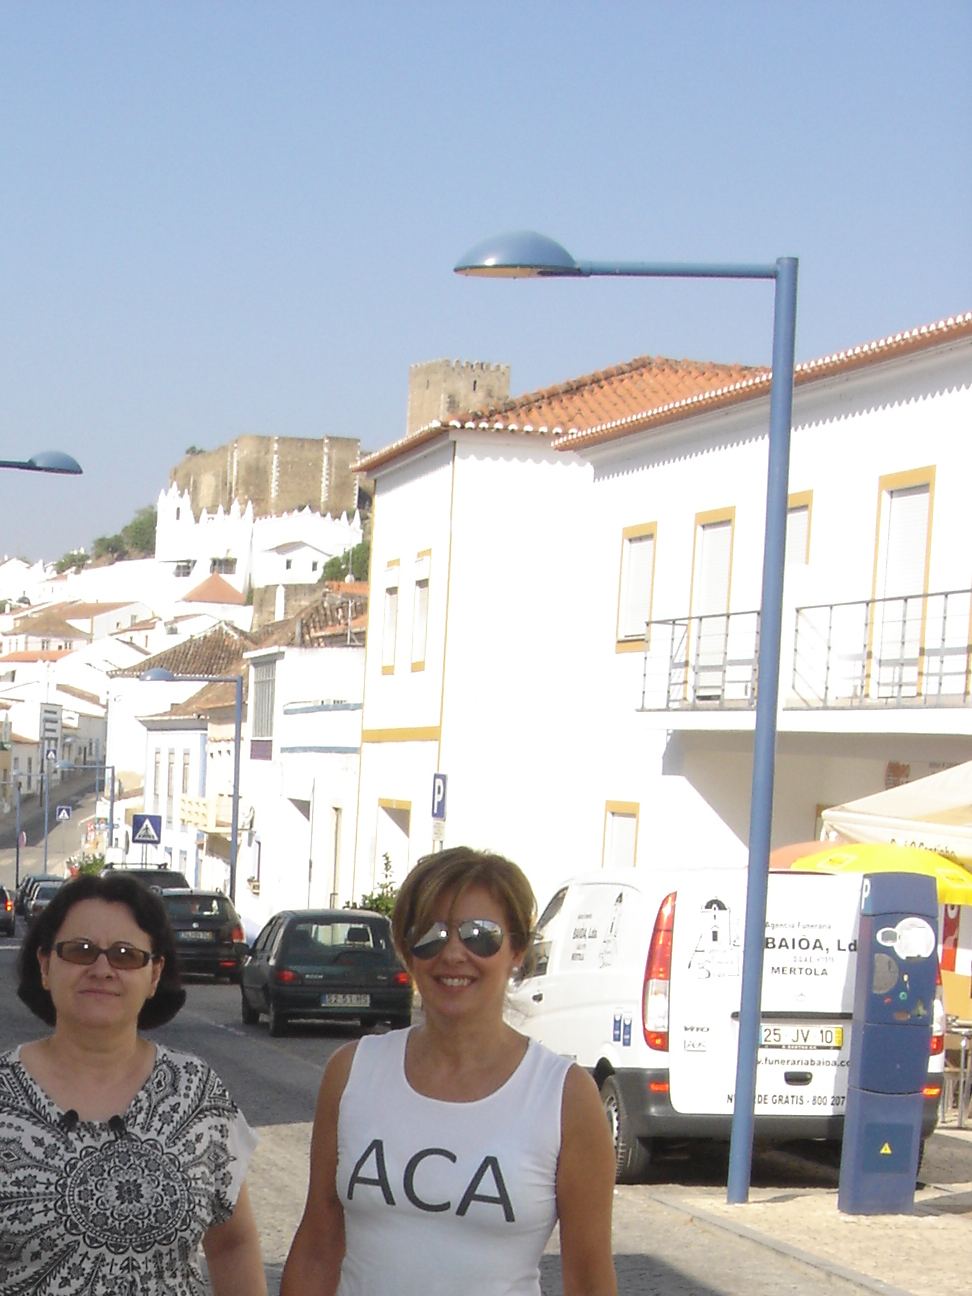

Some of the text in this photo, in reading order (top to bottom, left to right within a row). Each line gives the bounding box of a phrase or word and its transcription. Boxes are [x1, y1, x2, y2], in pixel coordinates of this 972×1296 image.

[433, 778, 444, 814] P
[861, 878, 871, 910] P
[830, 1095, 846, 1106] 207
[347, 1139, 516, 1223] ACA
